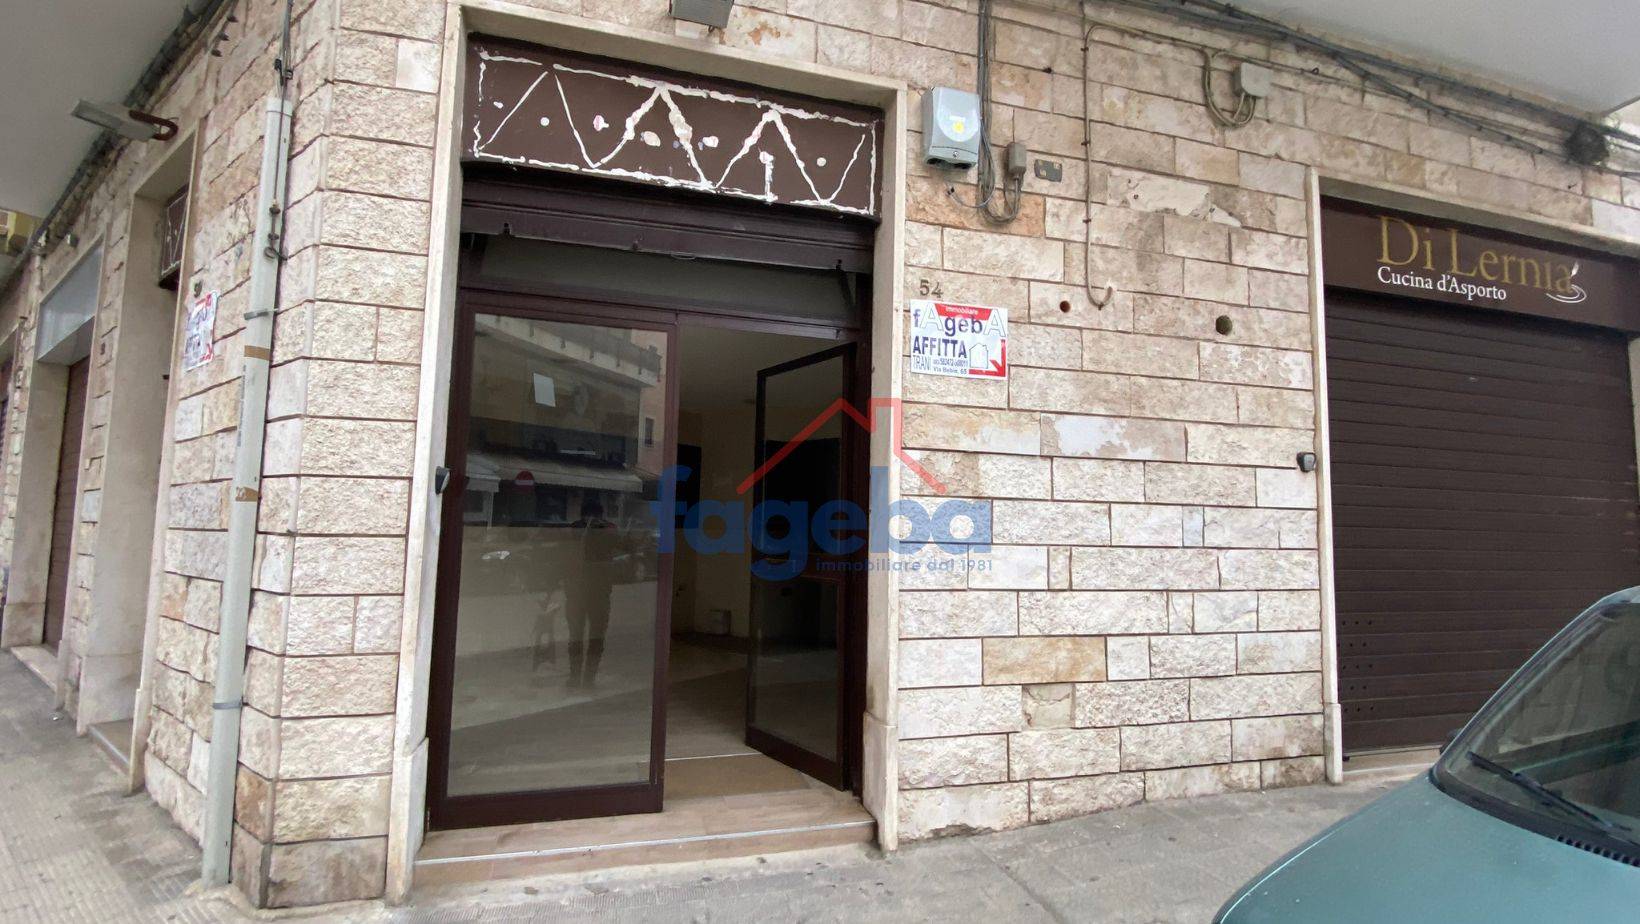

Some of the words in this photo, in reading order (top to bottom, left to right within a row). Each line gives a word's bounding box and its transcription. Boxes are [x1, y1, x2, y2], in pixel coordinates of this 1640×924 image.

[1376, 215, 1435, 271] Di
[1450, 227, 1573, 294] Lernia
[920, 279, 943, 298] 54
[1377, 265, 1433, 290] Cucina
[1437, 274, 1507, 300] d'Asporto
[912, 335, 967, 359] AFFITTA
